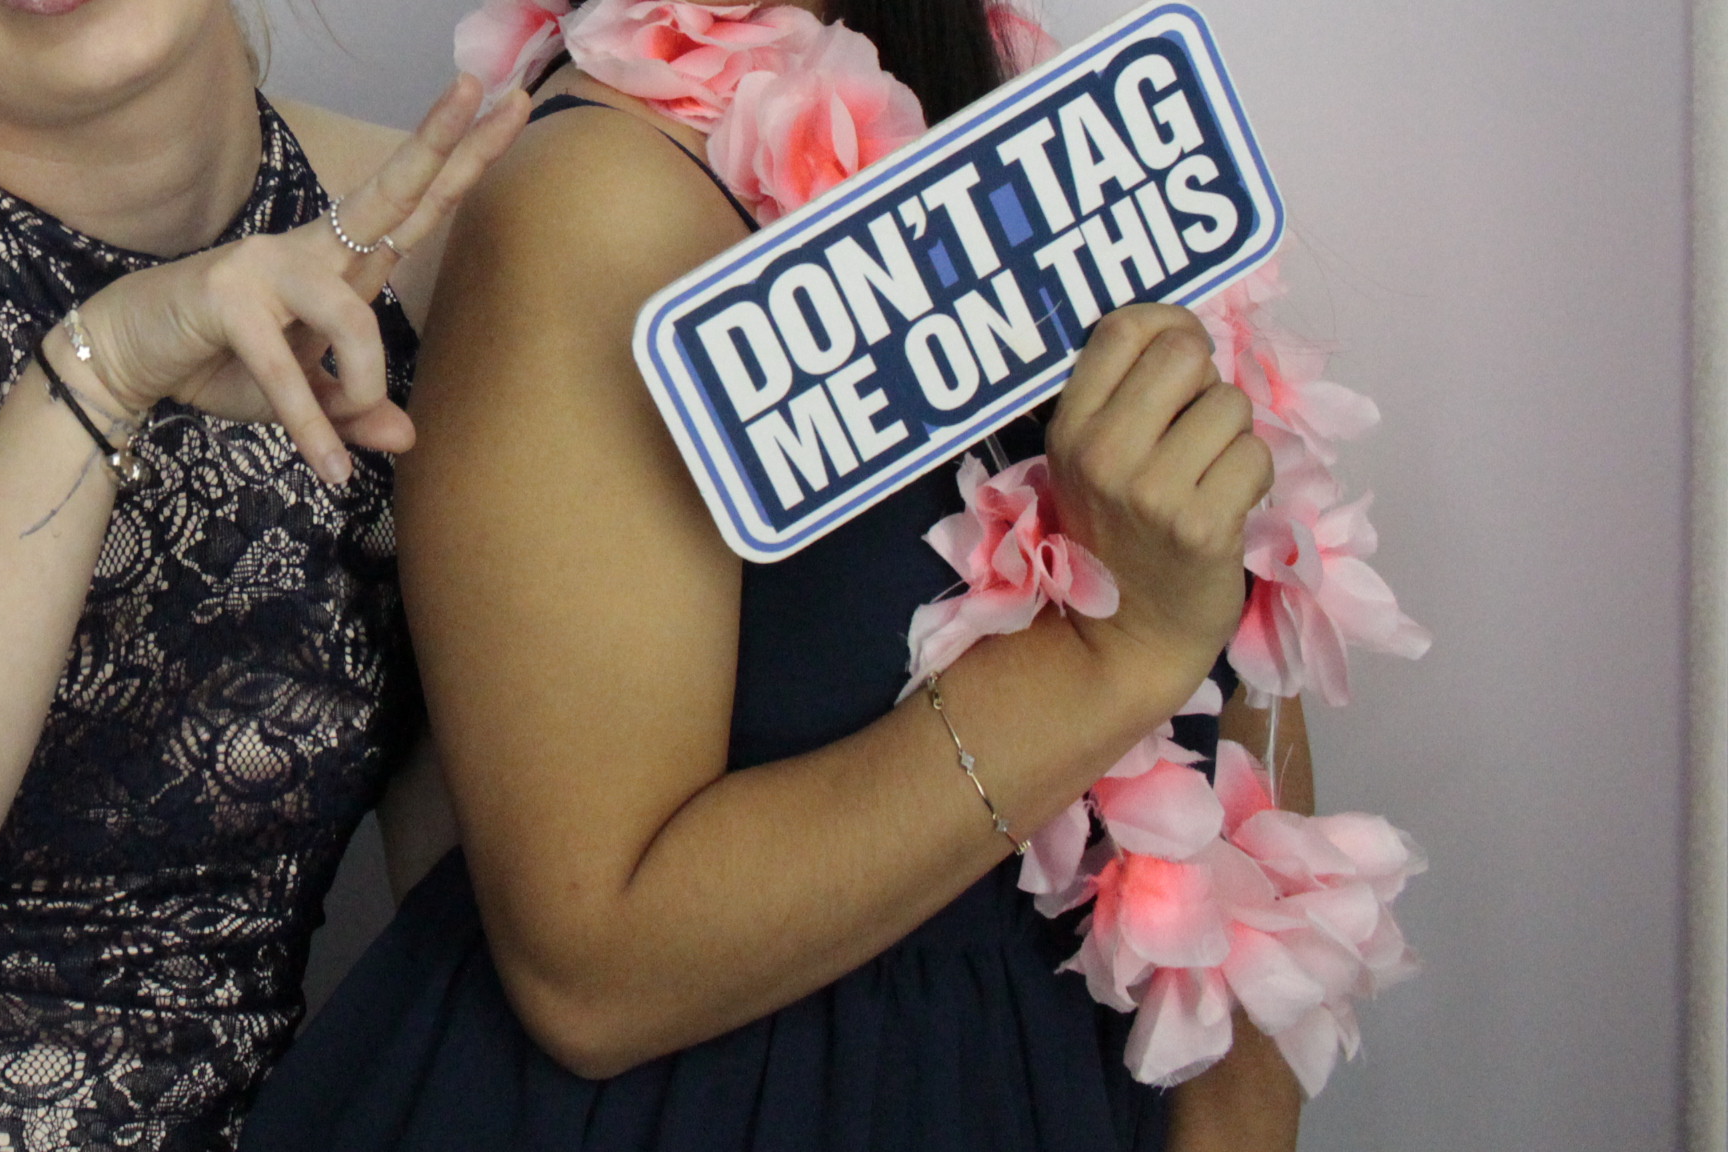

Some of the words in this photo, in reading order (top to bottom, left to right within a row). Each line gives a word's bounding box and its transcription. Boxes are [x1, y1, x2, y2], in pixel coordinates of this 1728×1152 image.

[696, 162, 1001, 422] DON'T
[996, 53, 1204, 233] TAG
[745, 353, 909, 511] ME
[904, 269, 1047, 411] ON
[1035, 154, 1238, 329] THIS
